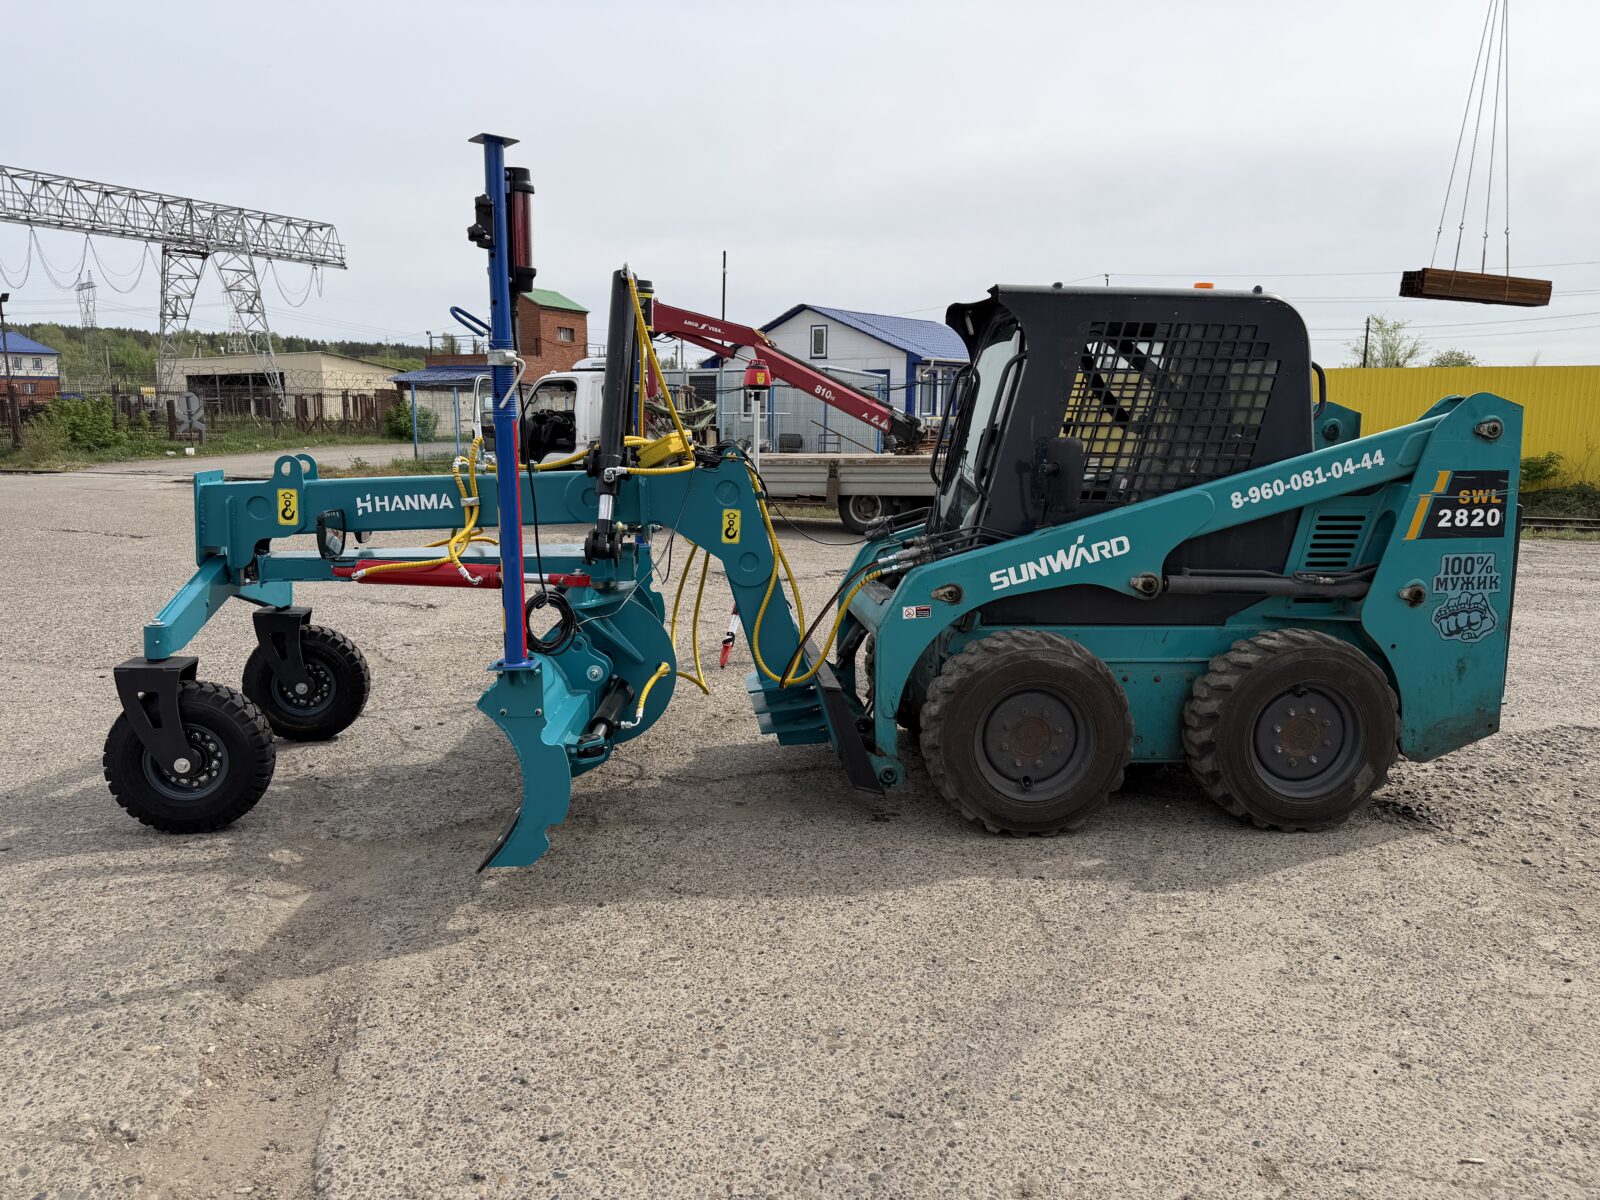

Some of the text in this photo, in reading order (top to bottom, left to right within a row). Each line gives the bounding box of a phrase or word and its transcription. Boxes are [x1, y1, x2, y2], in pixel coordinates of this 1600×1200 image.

[1230, 449, 1385, 509] 8-960-081-04-44
[374, 493, 454, 512] HANMA
[1458, 488, 1502, 504] SWL
[1437, 508, 1501, 528] 2820
[989, 534, 1131, 591] SUNWARD
[1443, 555, 1493, 576] 100%
[1435, 575, 1501, 592] МУЖИК
